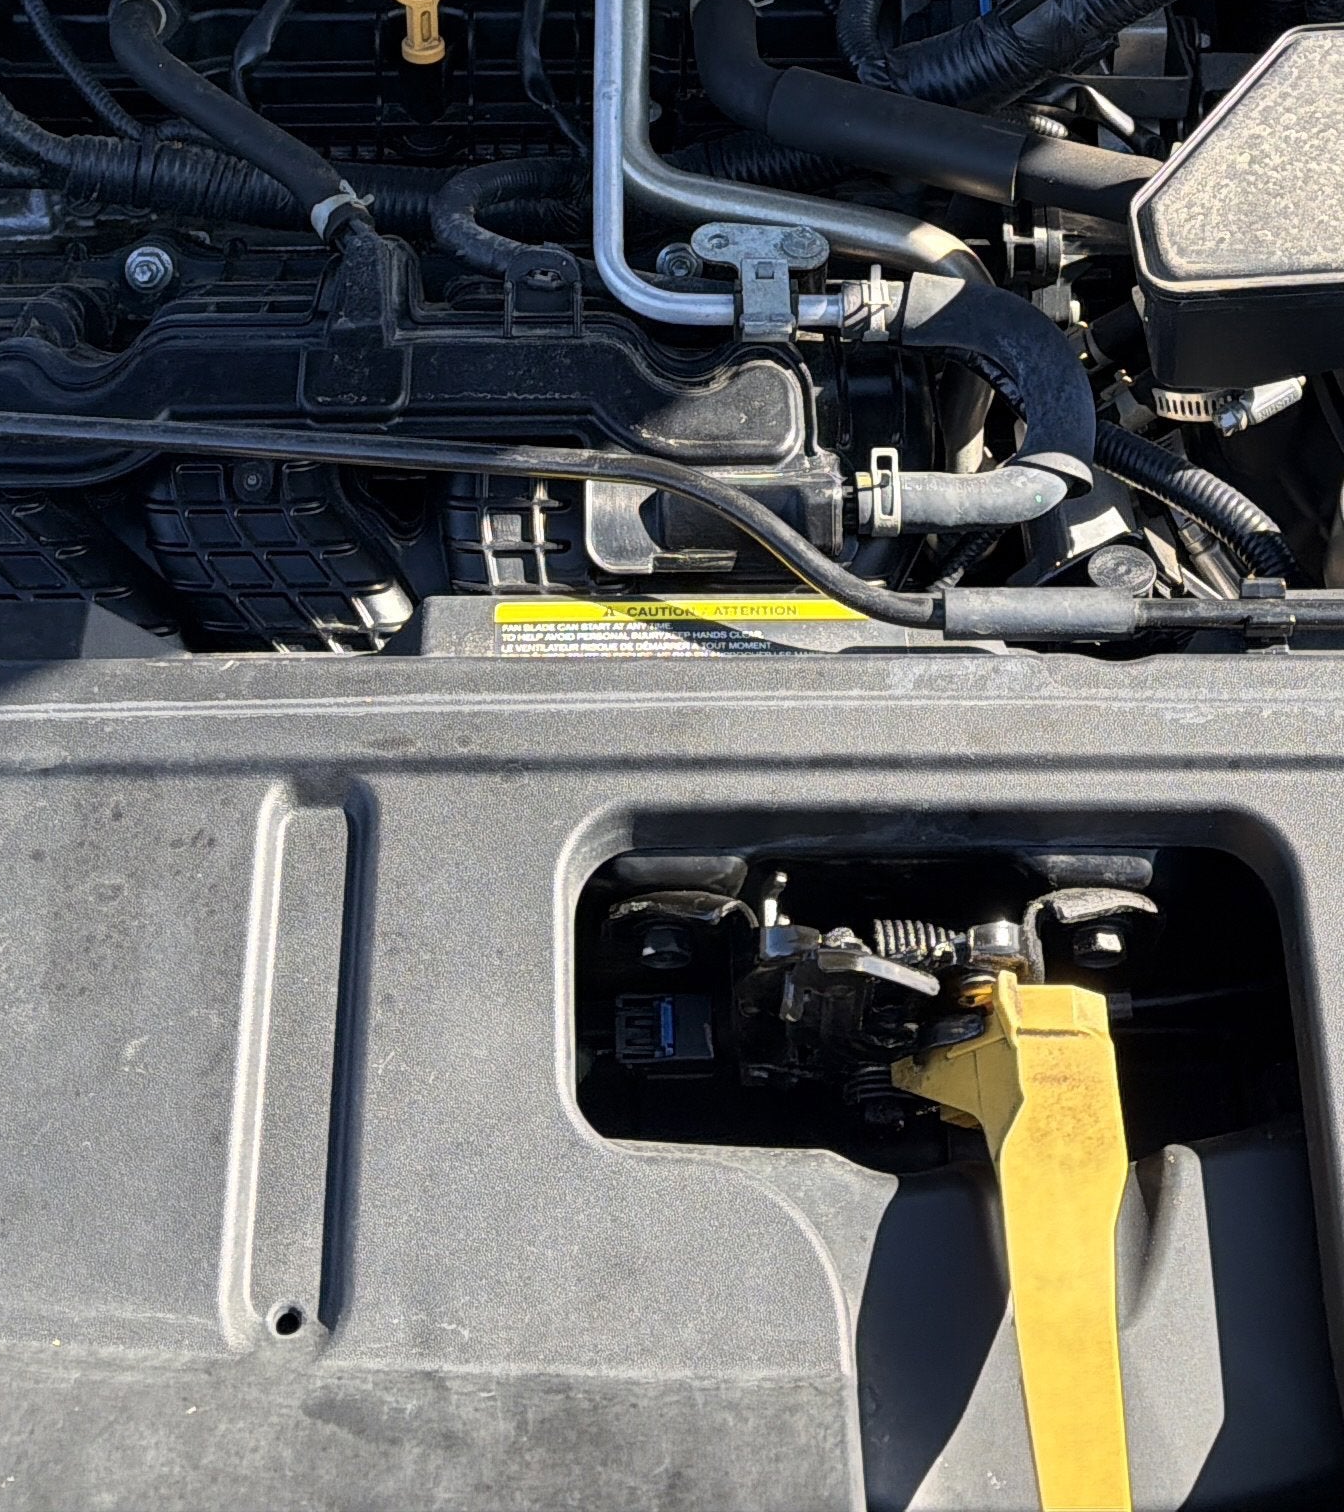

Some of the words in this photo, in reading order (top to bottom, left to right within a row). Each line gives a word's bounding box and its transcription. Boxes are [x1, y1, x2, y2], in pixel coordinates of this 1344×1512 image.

[626, 606, 696, 618] CAUTION
[713, 605, 797, 617] ATTENTION
[557, 623, 580, 632] CAN
[581, 622, 612, 631] START
[612, 622, 625, 630] AT
[626, 622, 647, 630] ANY
[501, 633, 516, 642] TO
[517, 633, 543, 641] HELP
[692, 630, 727, 639] HANDS
[501, 644, 514, 653] LE
[728, 641, 772, 650] MOMENT
